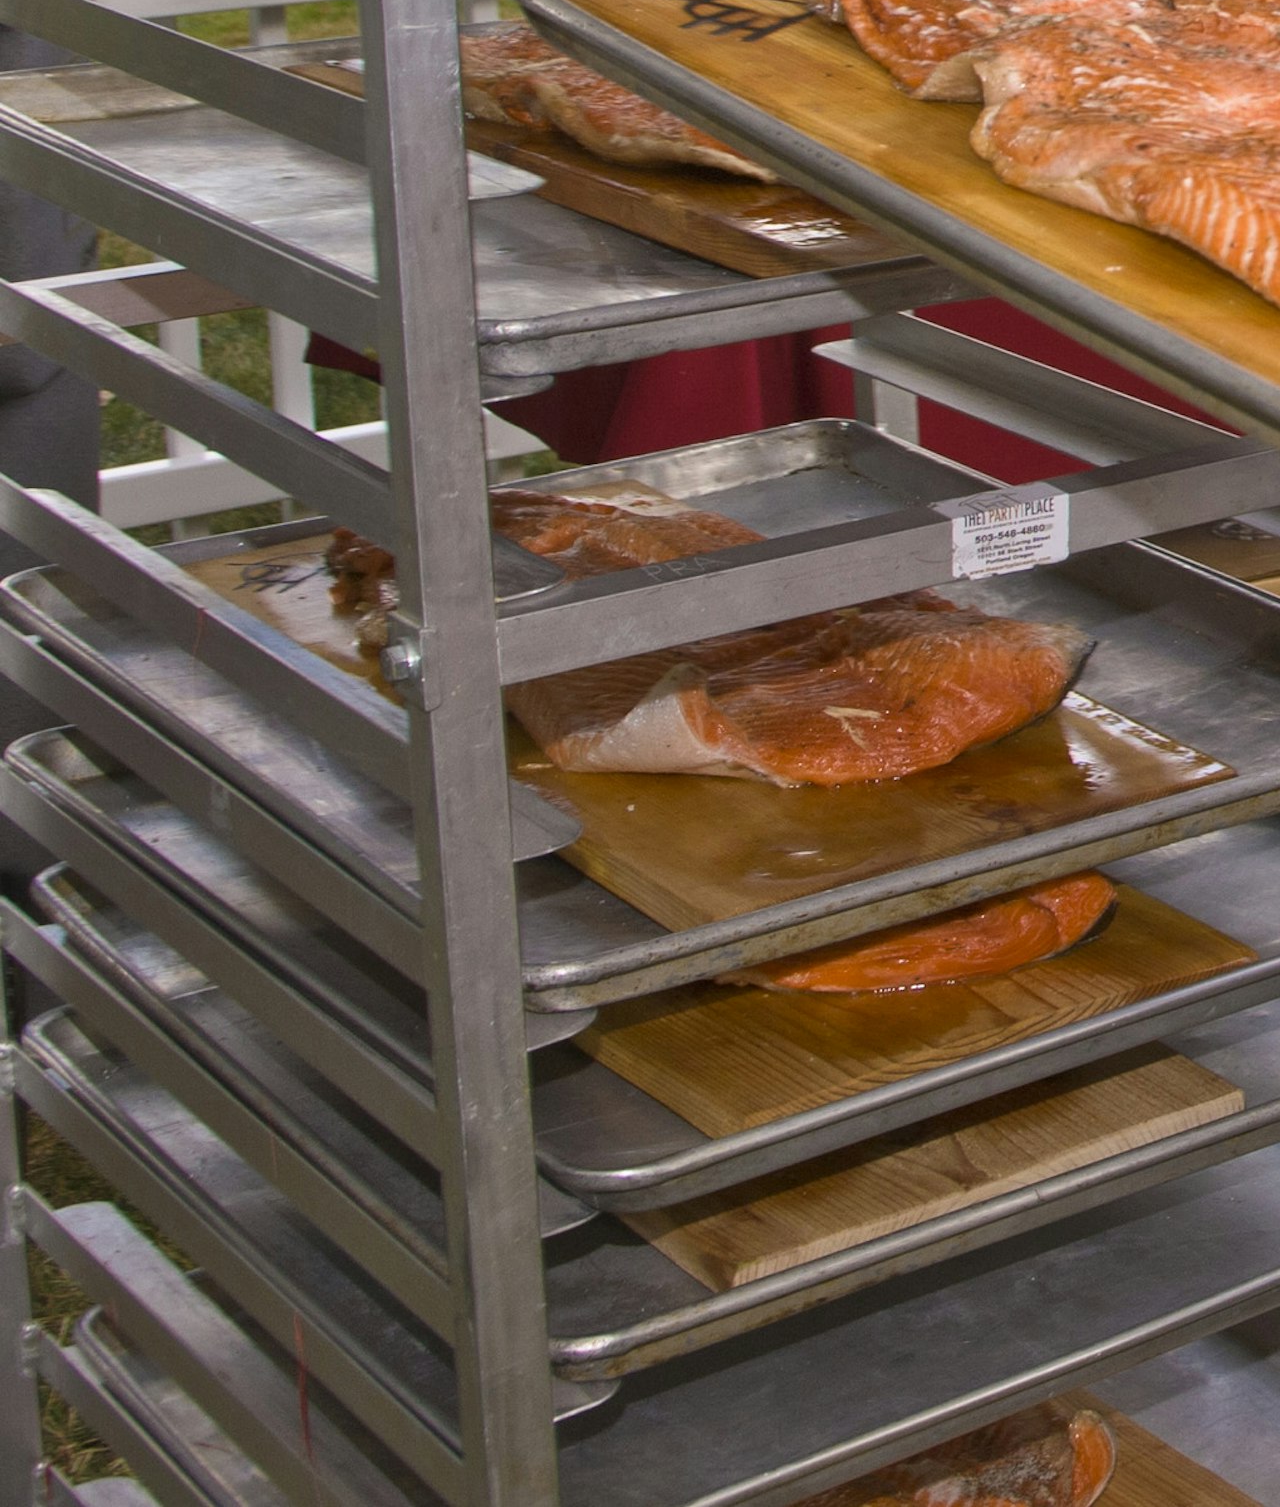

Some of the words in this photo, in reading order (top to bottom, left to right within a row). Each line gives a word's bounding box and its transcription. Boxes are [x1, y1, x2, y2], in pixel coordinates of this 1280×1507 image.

[964, 514, 981, 527] THE
[989, 507, 1020, 523] PARTY
[1024, 498, 1054, 516] PLACE
